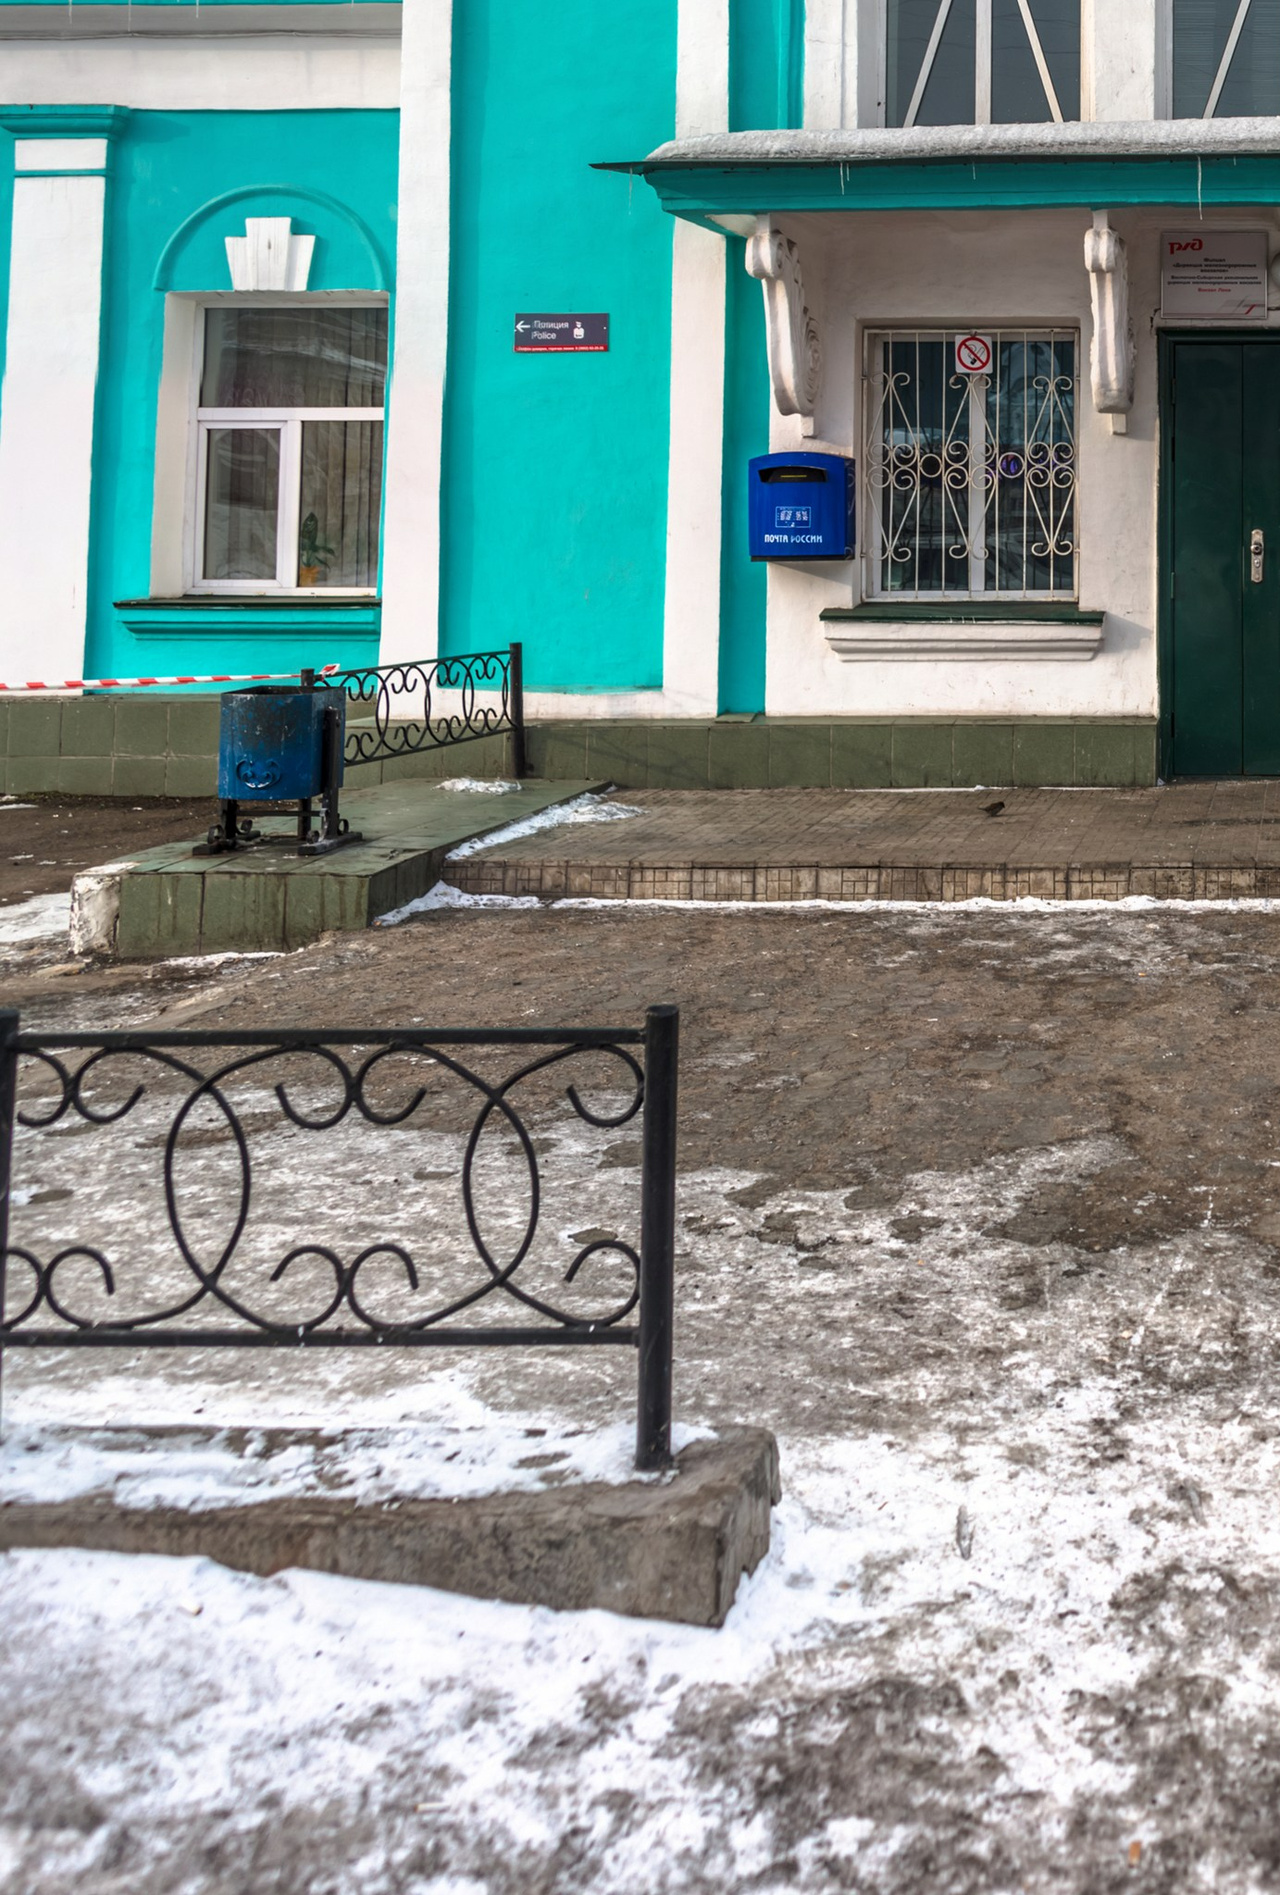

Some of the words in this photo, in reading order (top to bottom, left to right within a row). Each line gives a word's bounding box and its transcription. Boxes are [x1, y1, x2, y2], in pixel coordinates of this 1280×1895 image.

[532, 320, 569, 330] Полиция
[531, 331, 557, 340] Police
[764, 534, 789, 543] ПОЧТА
[790, 534, 823, 544] РОССИИ
